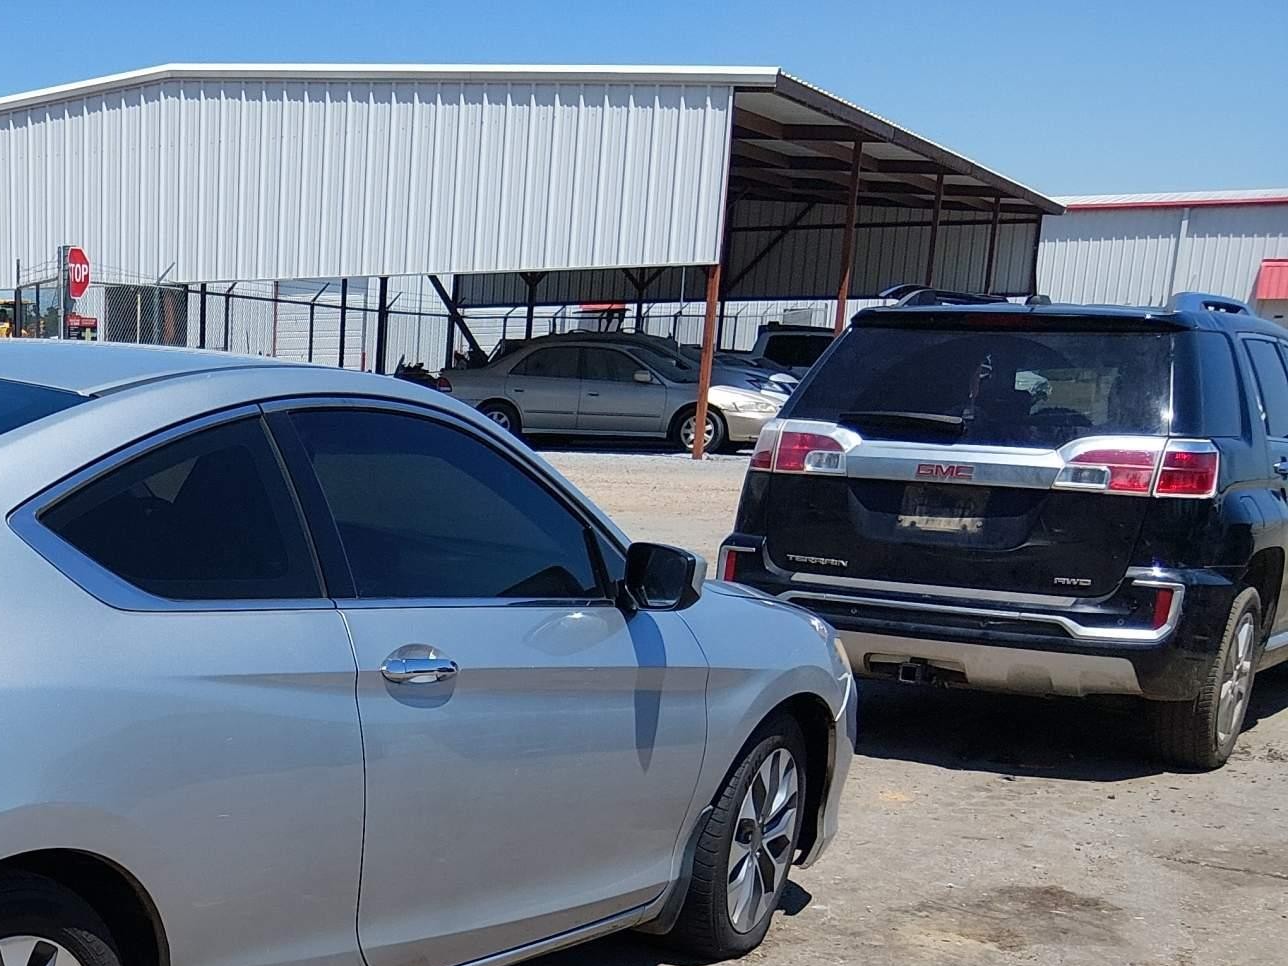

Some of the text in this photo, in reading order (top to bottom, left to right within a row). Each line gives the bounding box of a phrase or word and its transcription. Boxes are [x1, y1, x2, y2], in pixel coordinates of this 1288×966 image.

[69, 263, 88, 283] TOP
[916, 463, 975, 479] GMC
[786, 554, 849, 567] TERRAIN
[1053, 577, 1092, 586] AWD
